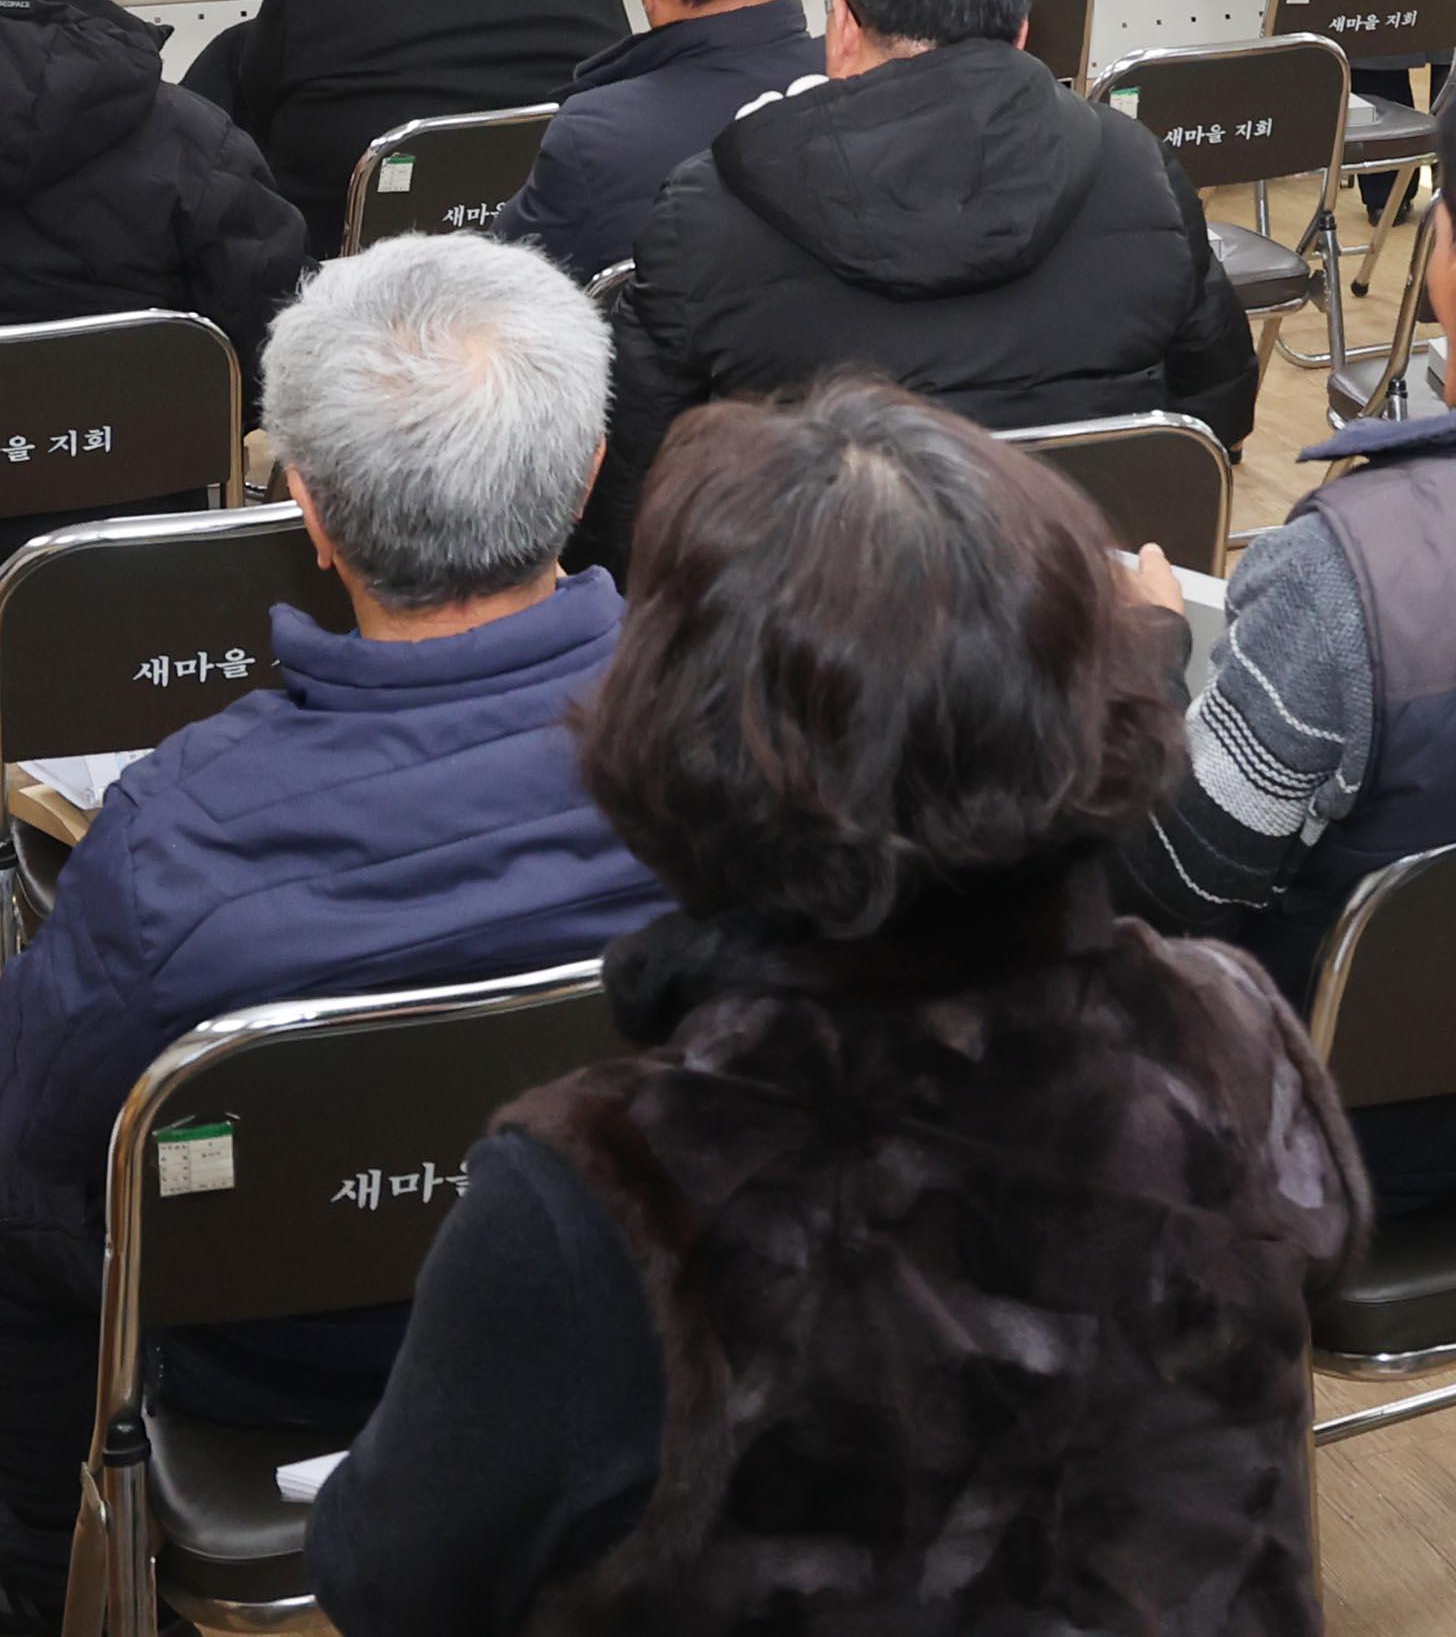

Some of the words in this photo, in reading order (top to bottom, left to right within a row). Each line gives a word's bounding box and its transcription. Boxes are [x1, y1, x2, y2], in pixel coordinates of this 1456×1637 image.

[1328, 13, 1381, 34] 새마을
[1386, 9, 1418, 29] 지회
[1163, 123, 1227, 148] 새마을
[1235, 117, 1273, 141] 지회
[47, 425, 112, 457] 지회
[132, 647, 257, 688] 새마을
